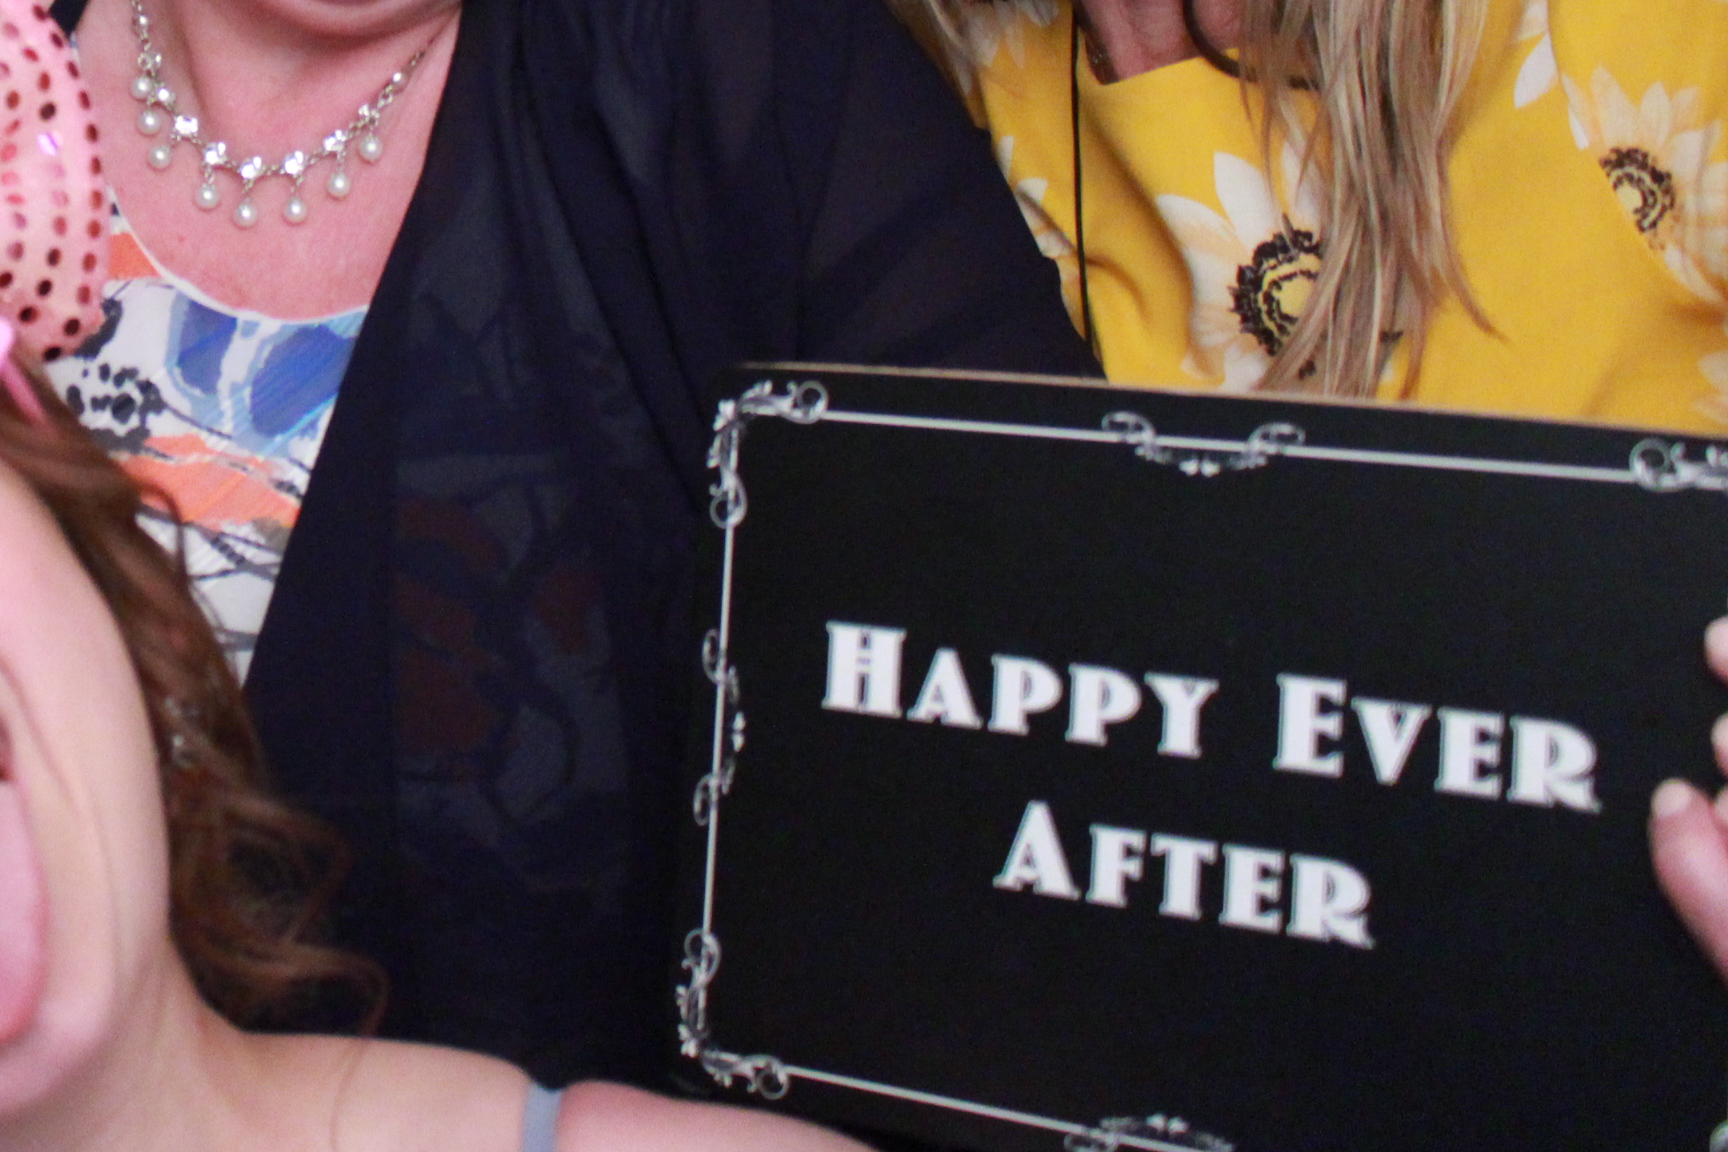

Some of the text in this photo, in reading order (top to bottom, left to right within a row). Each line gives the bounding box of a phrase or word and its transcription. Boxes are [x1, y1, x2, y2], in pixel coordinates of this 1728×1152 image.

[821, 621, 1600, 813] HAPPY EVER
[992, 800, 1373, 949] AFTER
